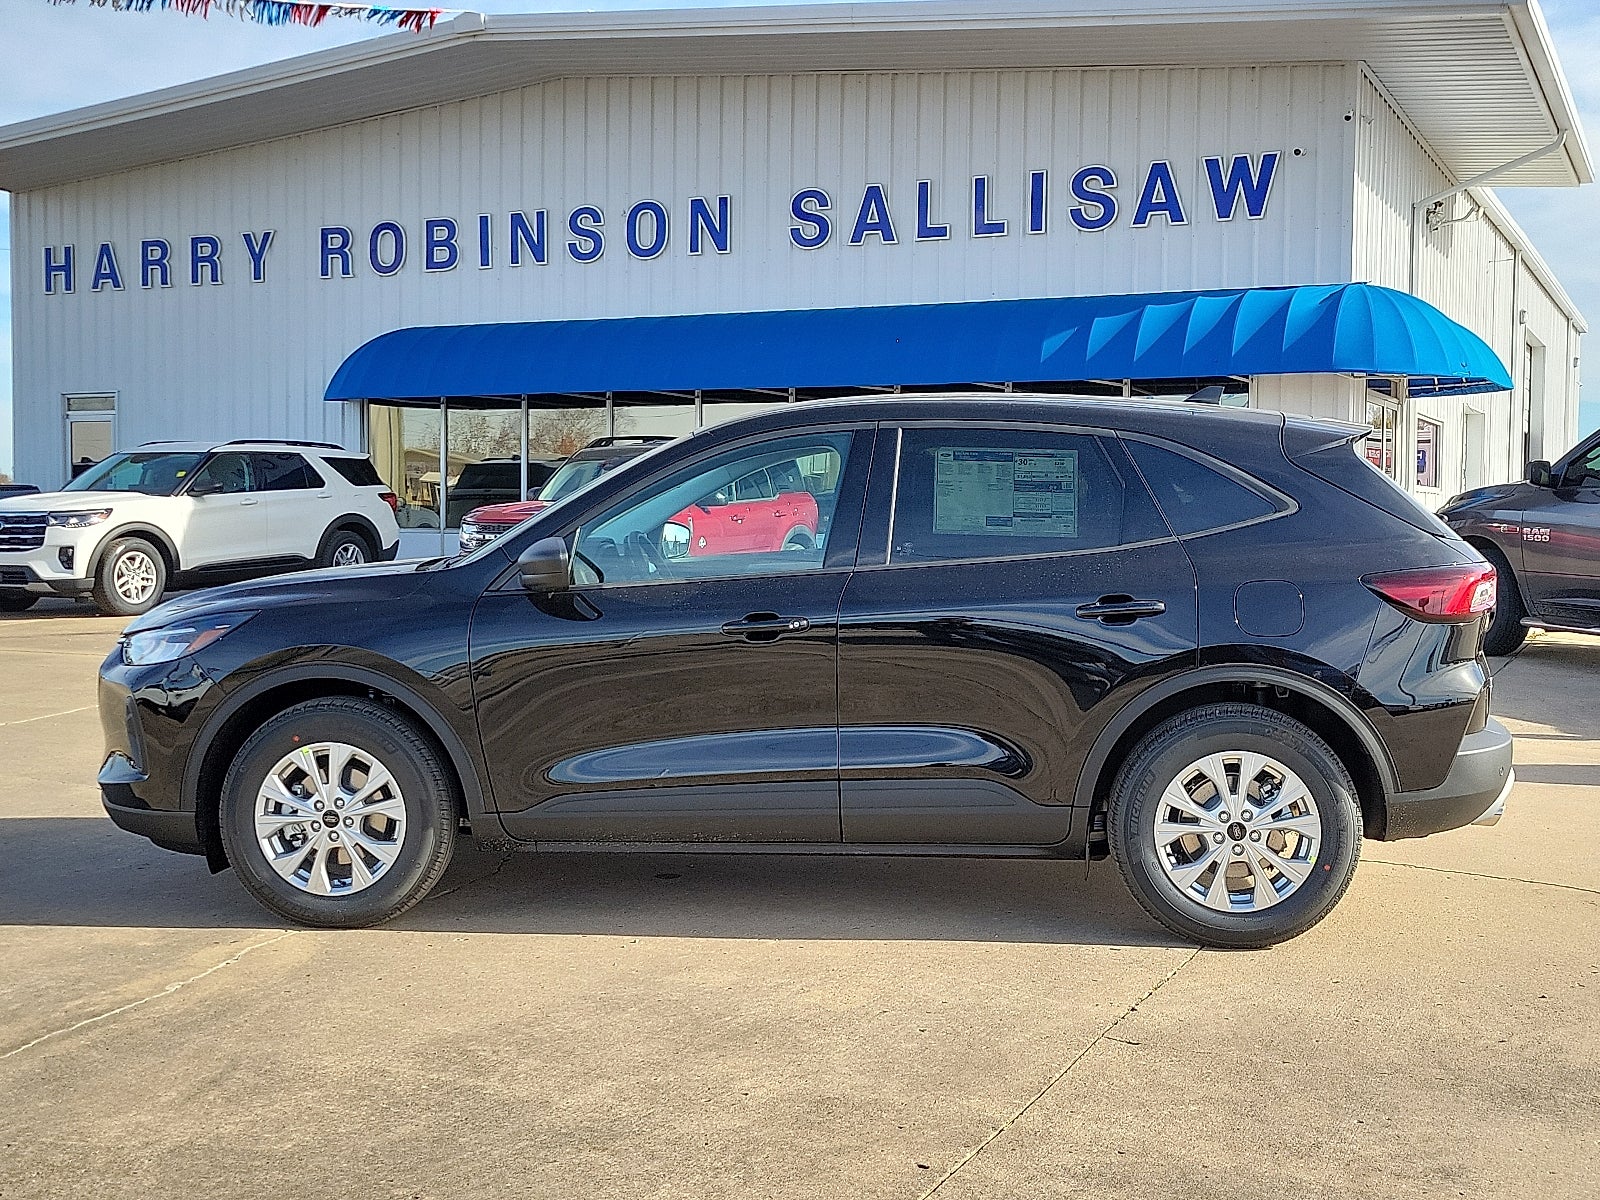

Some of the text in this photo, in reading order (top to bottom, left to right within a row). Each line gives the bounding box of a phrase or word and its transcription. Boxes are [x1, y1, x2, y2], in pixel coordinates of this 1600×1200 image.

[44, 150, 1282, 295] HARRY ROBINSON SALLISAW
[1523, 528, 1550, 536] RAM
[1130, 771, 1156, 835] MICHELIN
